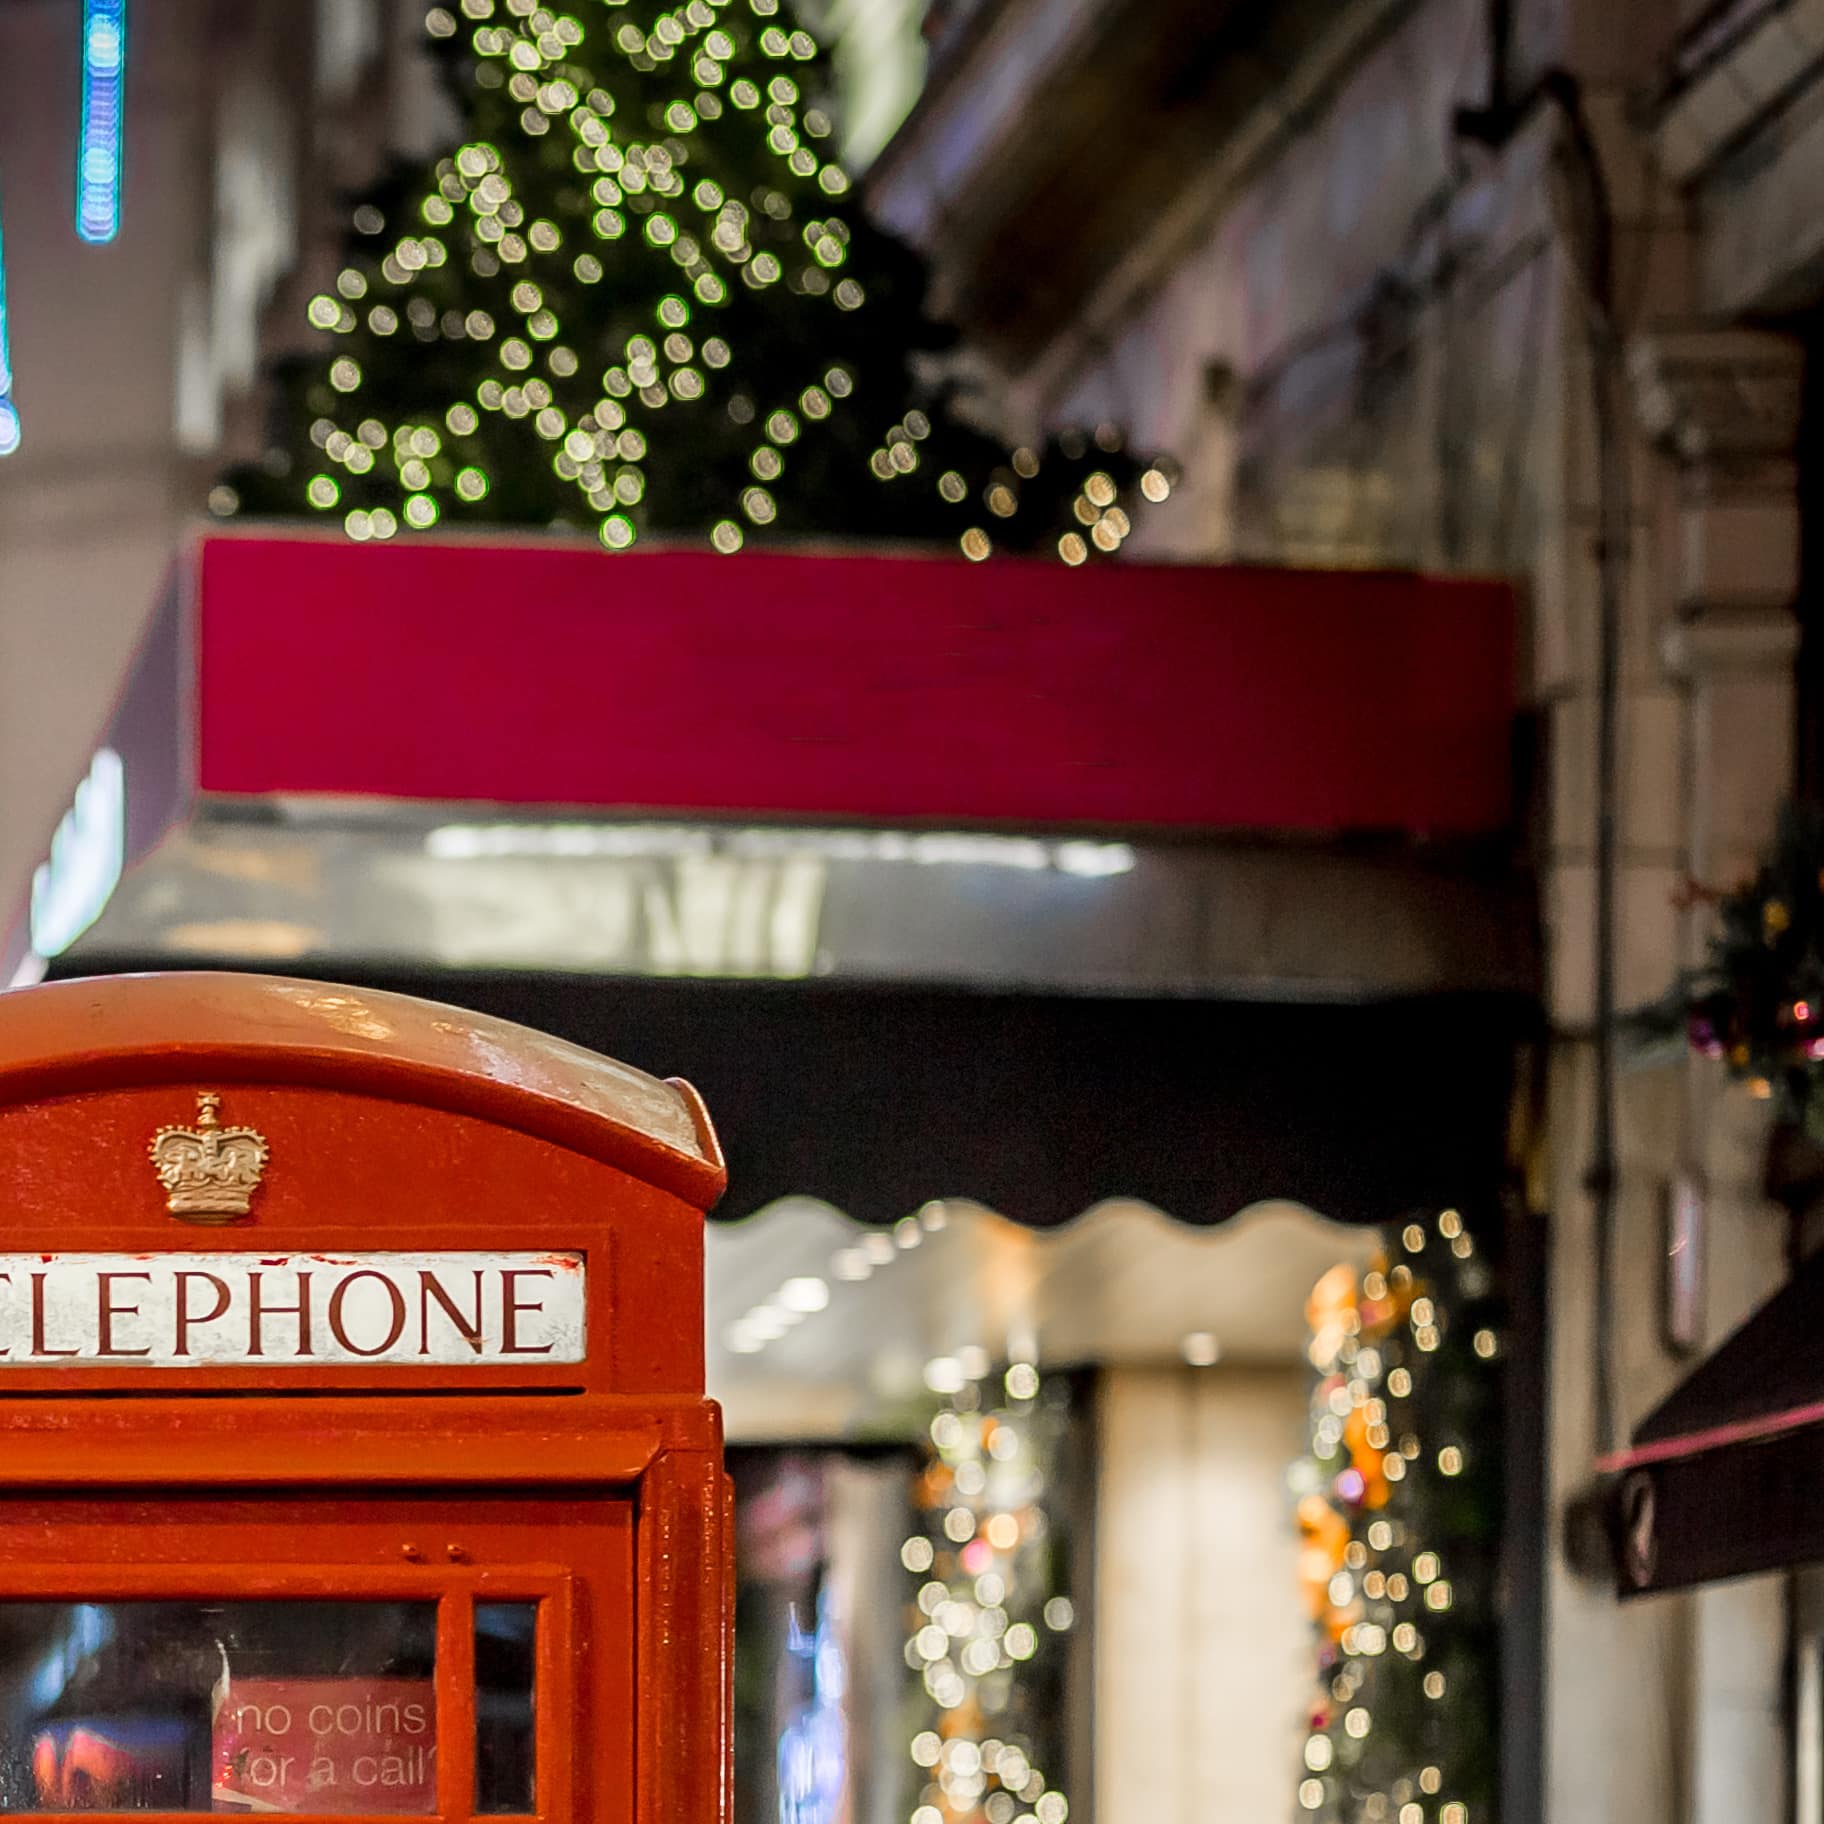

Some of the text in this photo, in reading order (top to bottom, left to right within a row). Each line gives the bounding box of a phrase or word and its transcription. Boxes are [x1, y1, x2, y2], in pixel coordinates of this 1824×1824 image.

[237, 1694, 427, 1735] no coins
[310, 1756, 337, 1786] a
